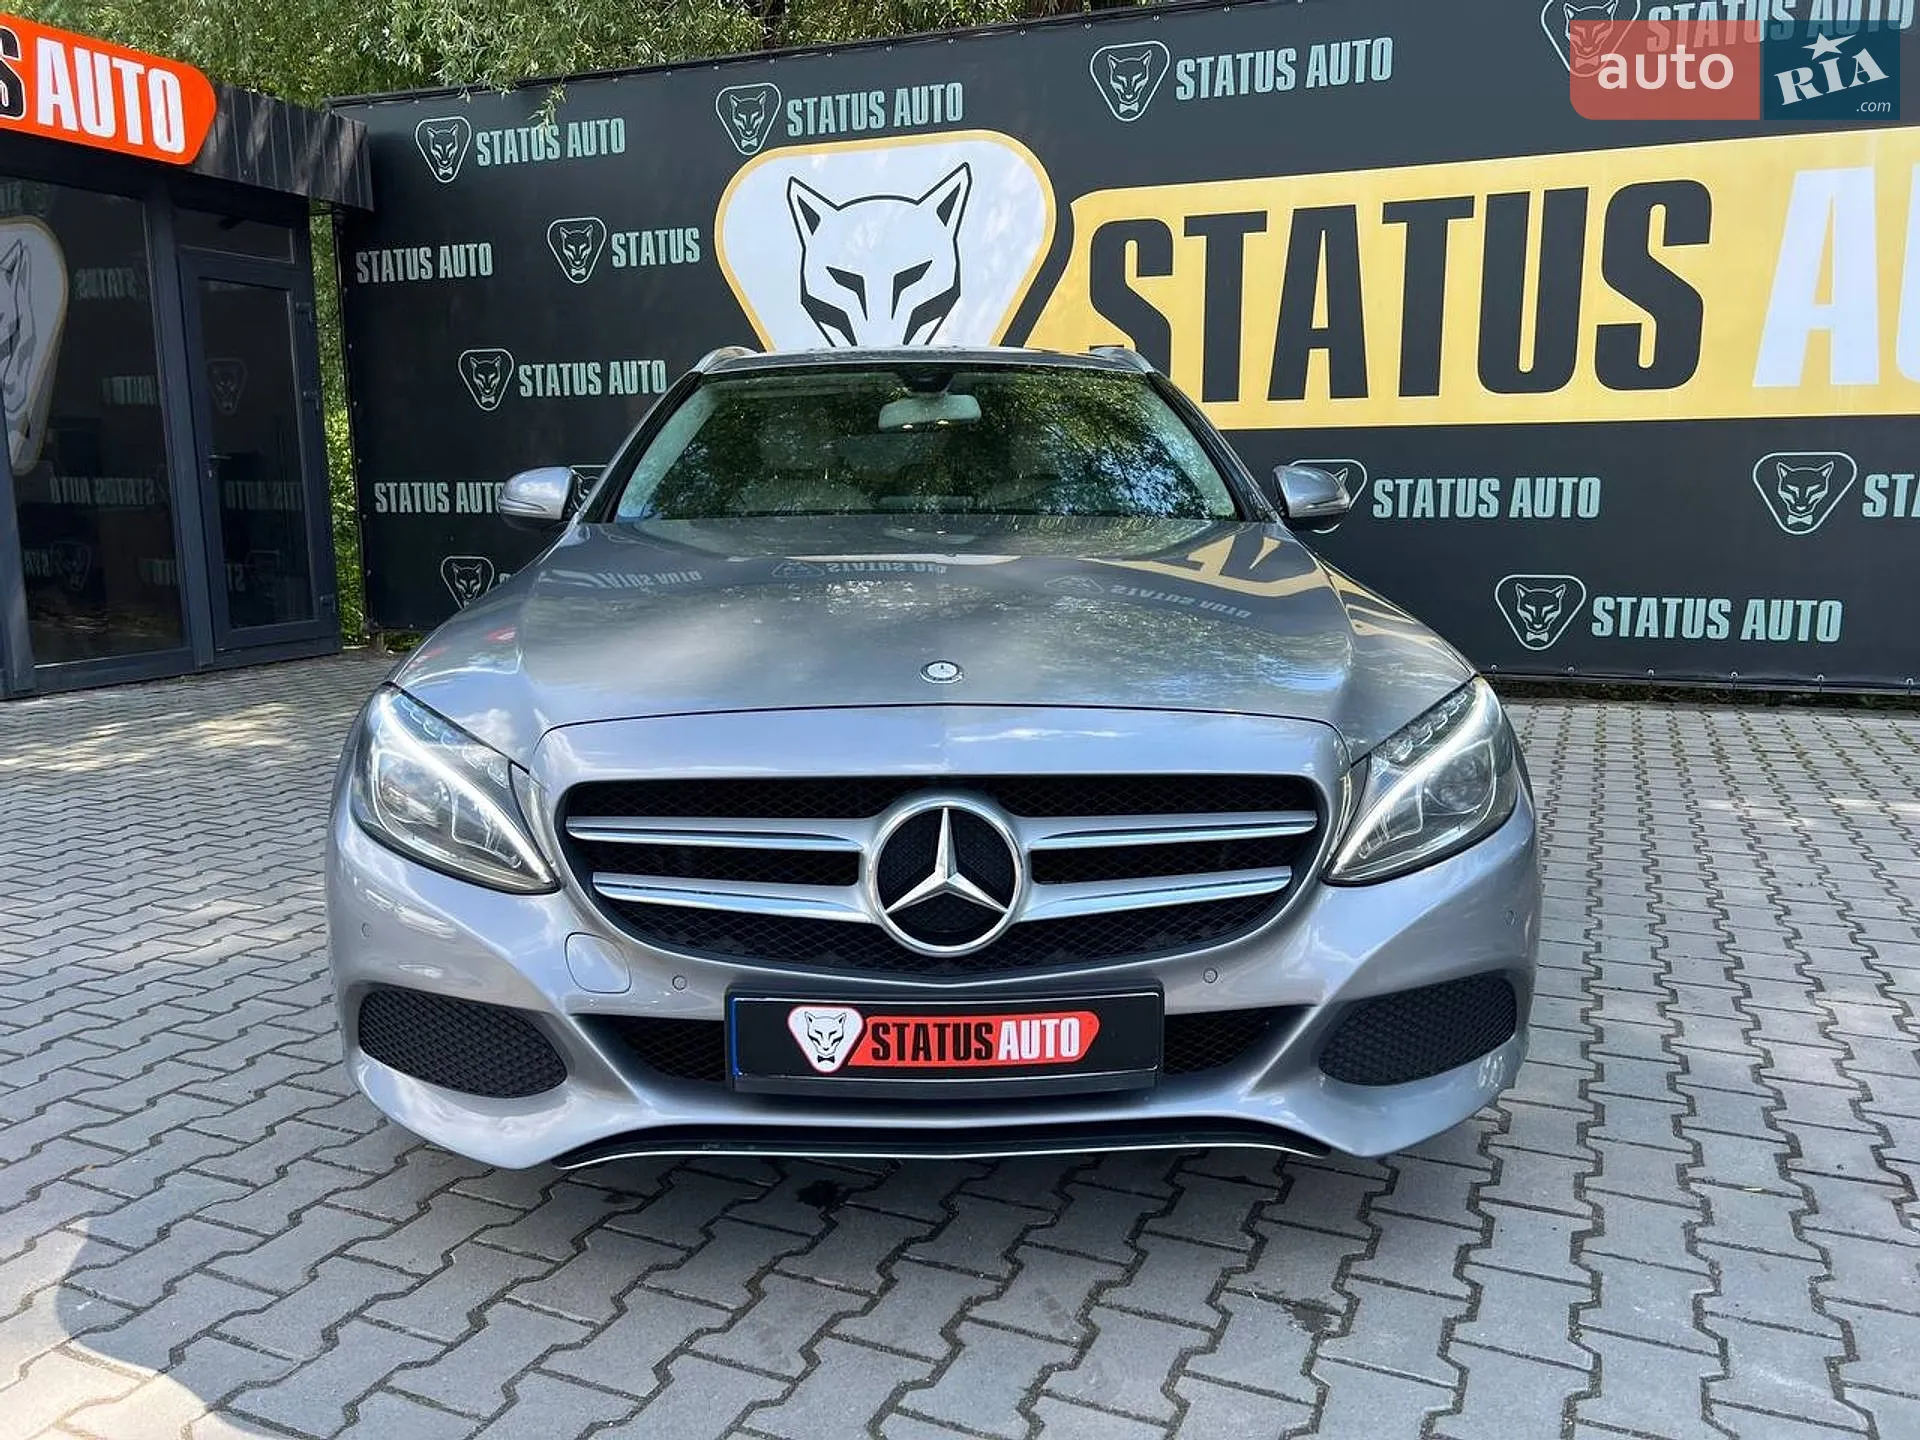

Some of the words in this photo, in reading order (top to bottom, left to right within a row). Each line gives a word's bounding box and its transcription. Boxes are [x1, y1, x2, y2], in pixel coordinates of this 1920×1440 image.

[1645, 0, 1797, 52] STATUS
[1175, 47, 1297, 101] STATUS
[1305, 36, 1394, 89] AUTO
[36, 36, 187, 154] AUTO
[786, 90, 886, 137] STATUS
[893, 82, 964, 128] AUTO
[475, 125, 560, 167] STATUS
[566, 118, 627, 158] AUTO
[355, 248, 433, 284] STATUS
[439, 242, 494, 279] AUTO
[611, 228, 701, 269] STATUS
[1089, 180, 1712, 402] STATUS
[1752, 162, 1920, 388] A
[518, 361, 602, 398] STATUS
[608, 359, 668, 396] AUTO
[373, 481, 450, 514] STATUS
[1371, 477, 1500, 519] STATUS
[1509, 476, 1601, 519] AUTO
[1862, 473, 1920, 518] ST
[1591, 596, 1730, 640] STATUS
[1740, 599, 1844, 643] AUTO
